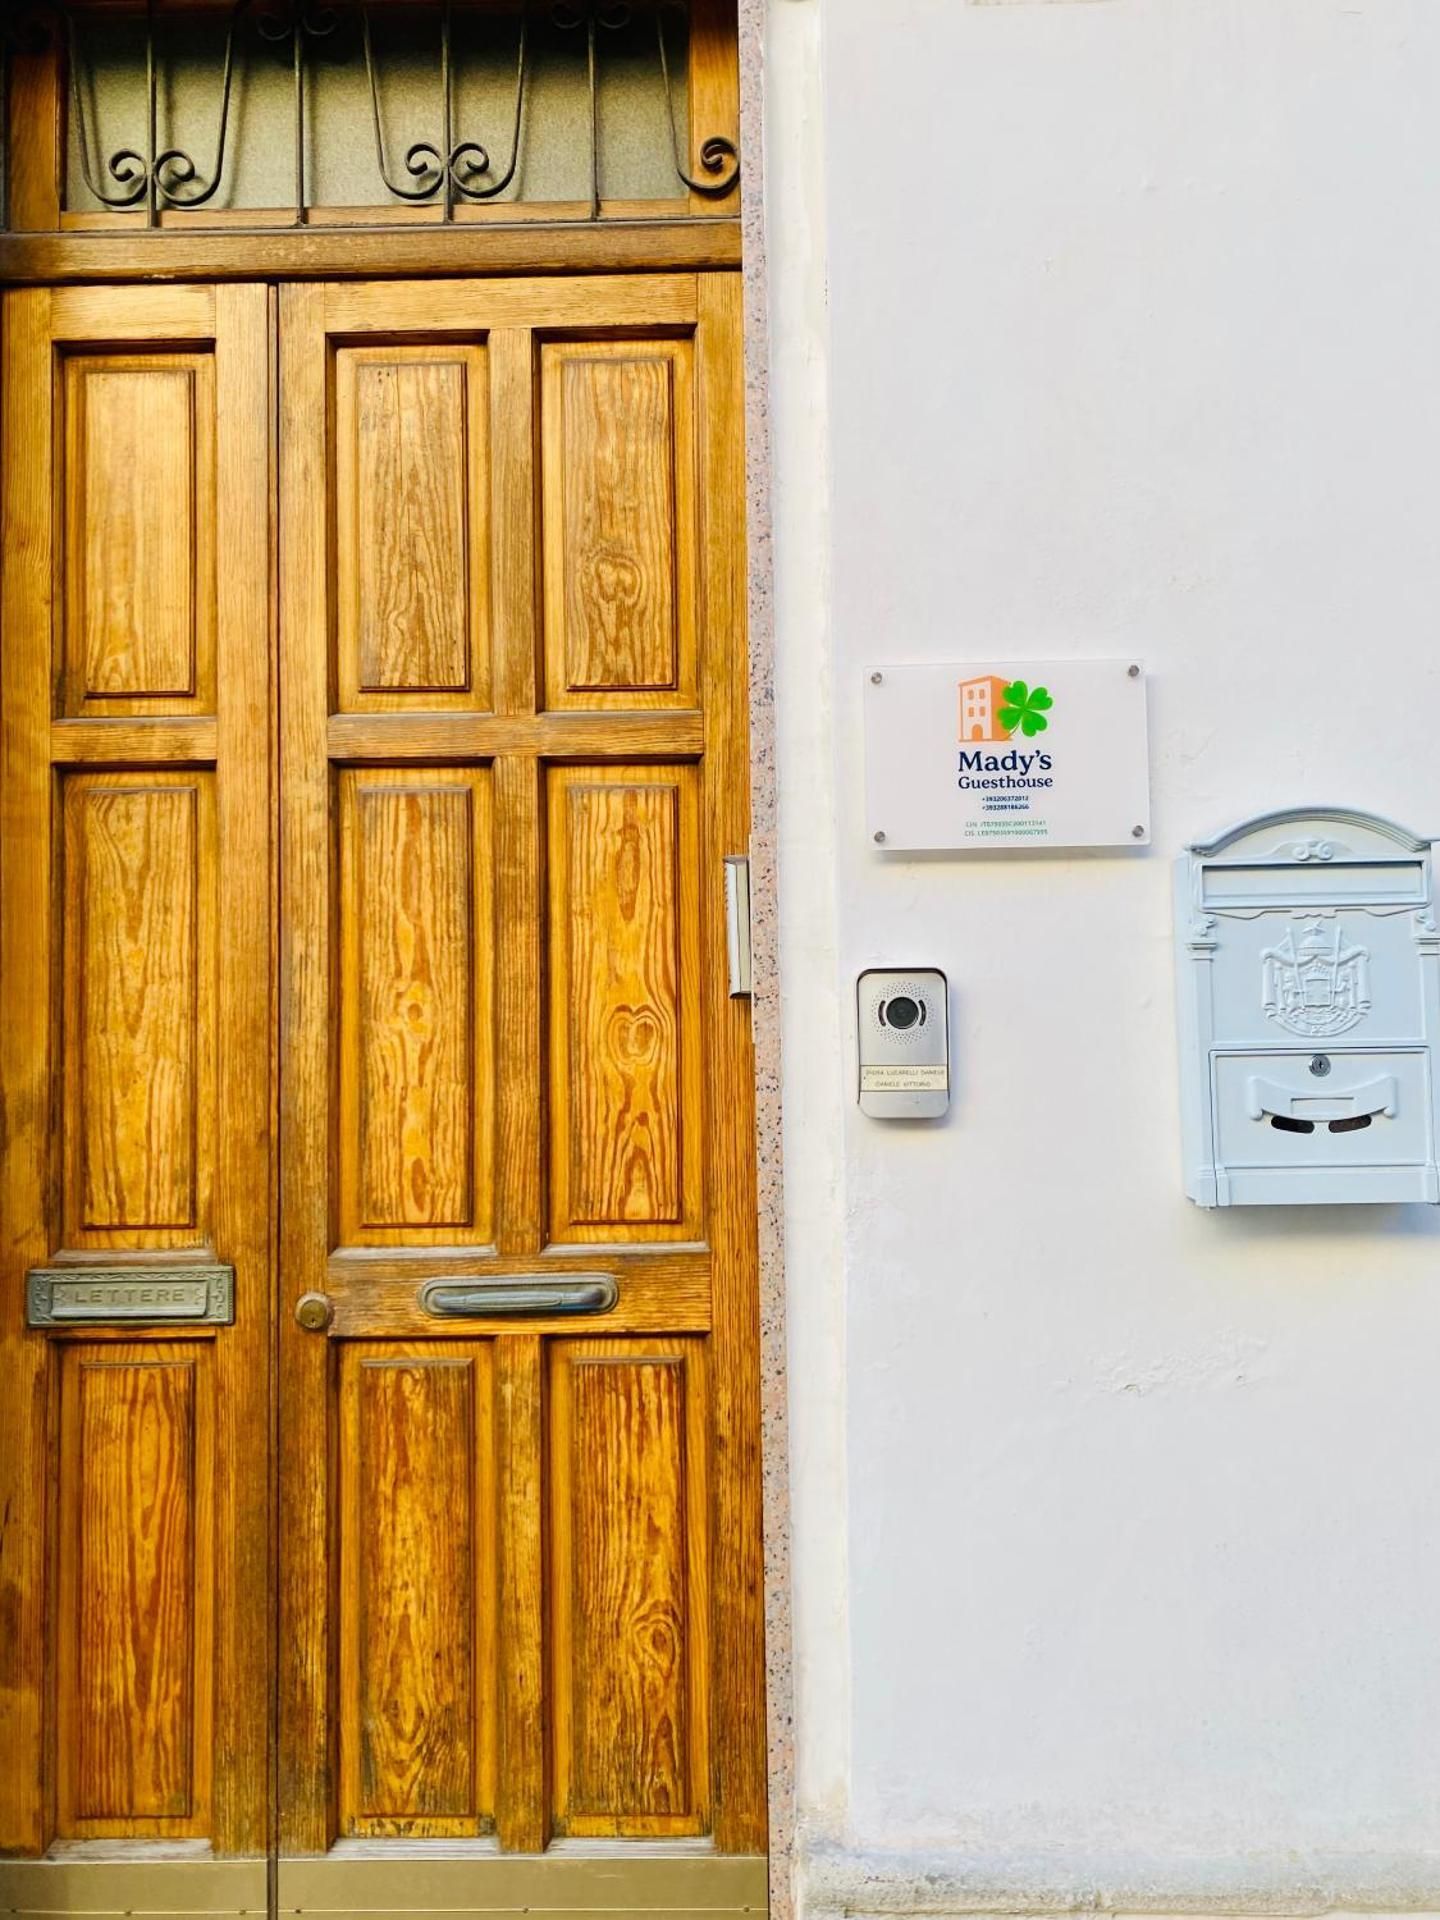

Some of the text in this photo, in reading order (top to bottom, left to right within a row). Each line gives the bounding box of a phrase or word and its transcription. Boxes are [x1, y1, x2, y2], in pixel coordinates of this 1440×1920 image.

[958, 749, 1052, 776] Mady’s
[958, 775, 1053, 789] Guesthouse
[75, 1288, 185, 1303] LETTERE
